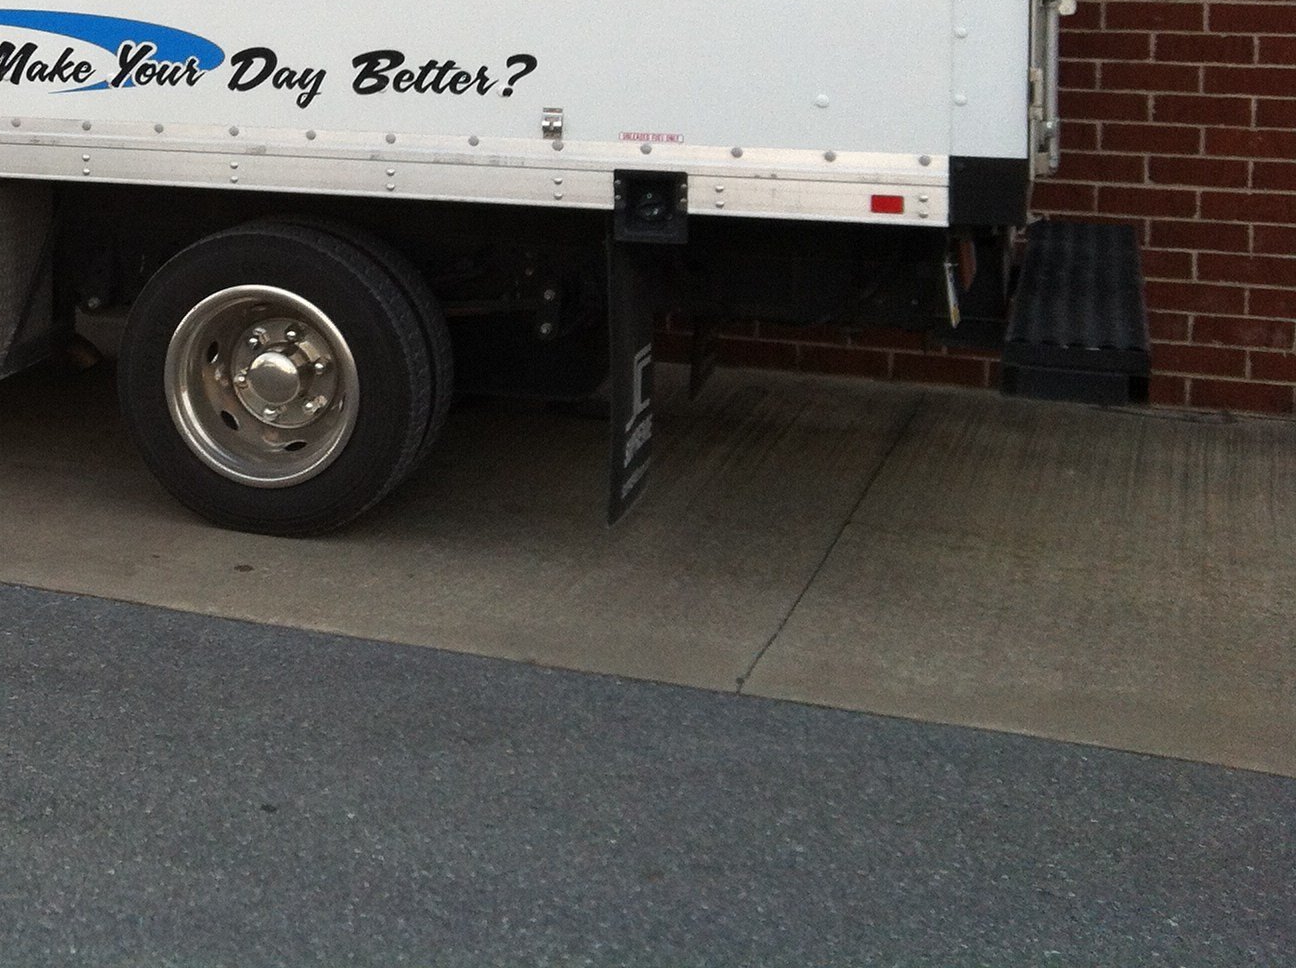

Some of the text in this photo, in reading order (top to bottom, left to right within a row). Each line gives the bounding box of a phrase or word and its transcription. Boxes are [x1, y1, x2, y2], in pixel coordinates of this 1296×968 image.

[110, 44, 205, 88] Your
[227, 46, 327, 109] Day
[351, 49, 538, 98] Better?
